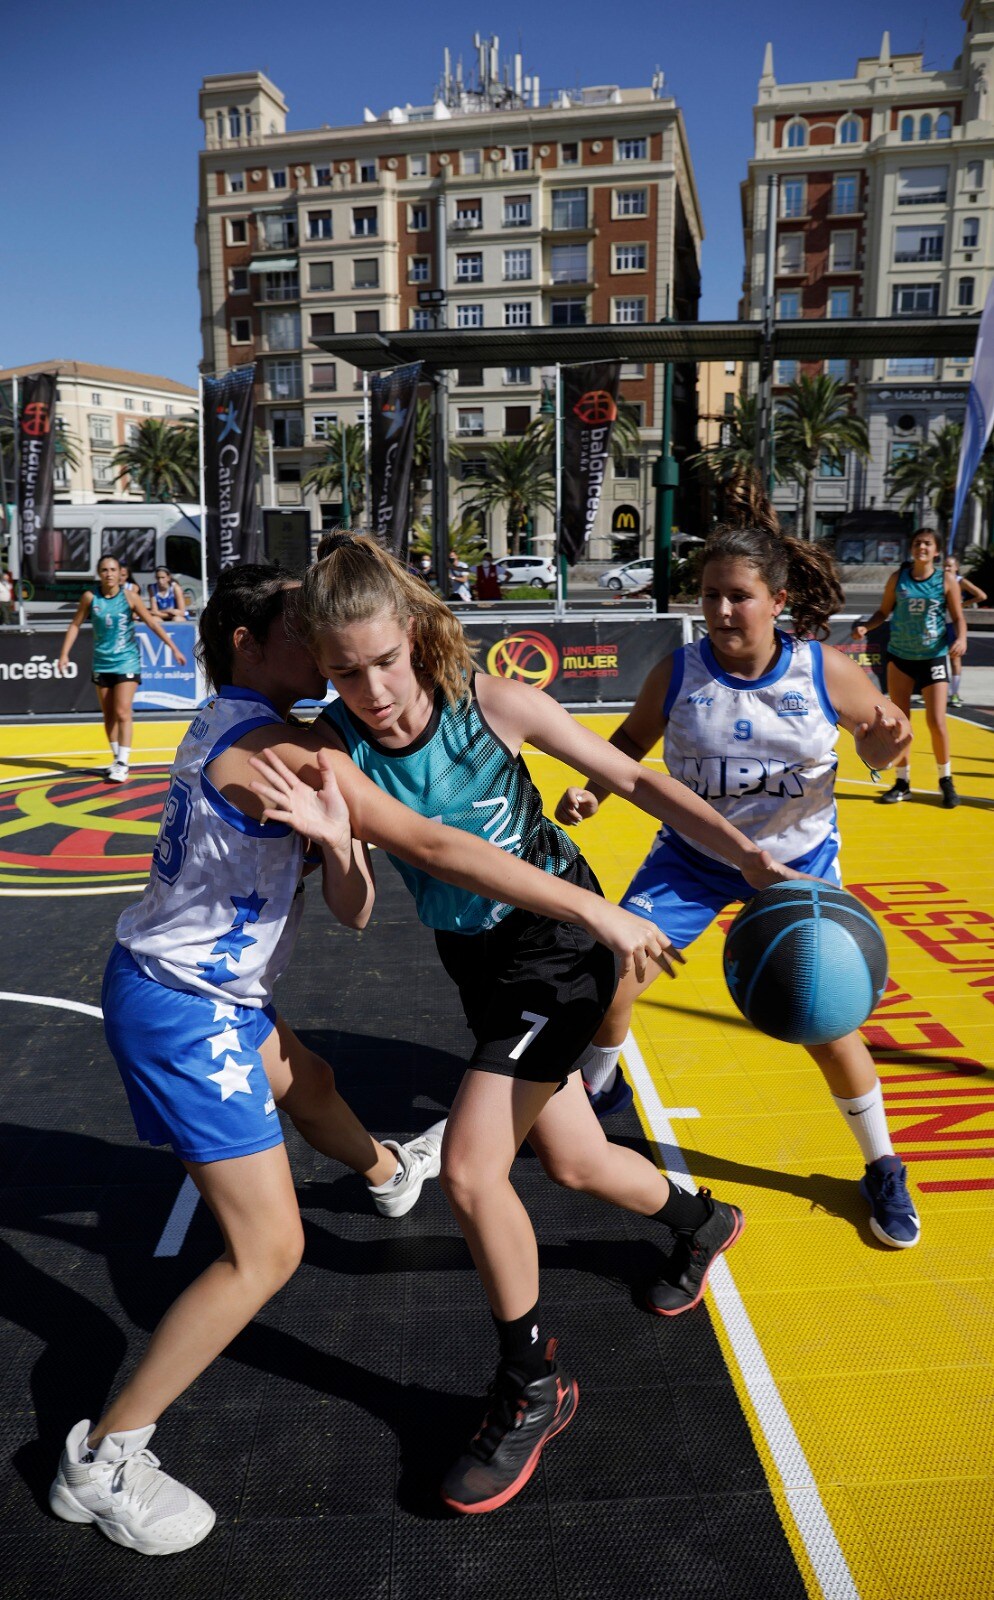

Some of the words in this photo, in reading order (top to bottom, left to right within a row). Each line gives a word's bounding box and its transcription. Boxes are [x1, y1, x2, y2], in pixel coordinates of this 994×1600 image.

[894, 390, 931, 401] Unicaja
[933, 390, 965, 400] Banco
[219, 443, 240, 571] CaixaBank
[908, 598, 925, 612] 23
[562, 645, 618, 656] UNIVERSO
[563, 655, 618, 669] MUJER
[931, 665, 946, 680] 23
[777, 697, 809, 712] MBK
[733, 718, 753, 741] 9
[683, 756, 804, 800] MBK
[627, 895, 655, 914] MBK
[508, 1010, 549, 1060] 7
